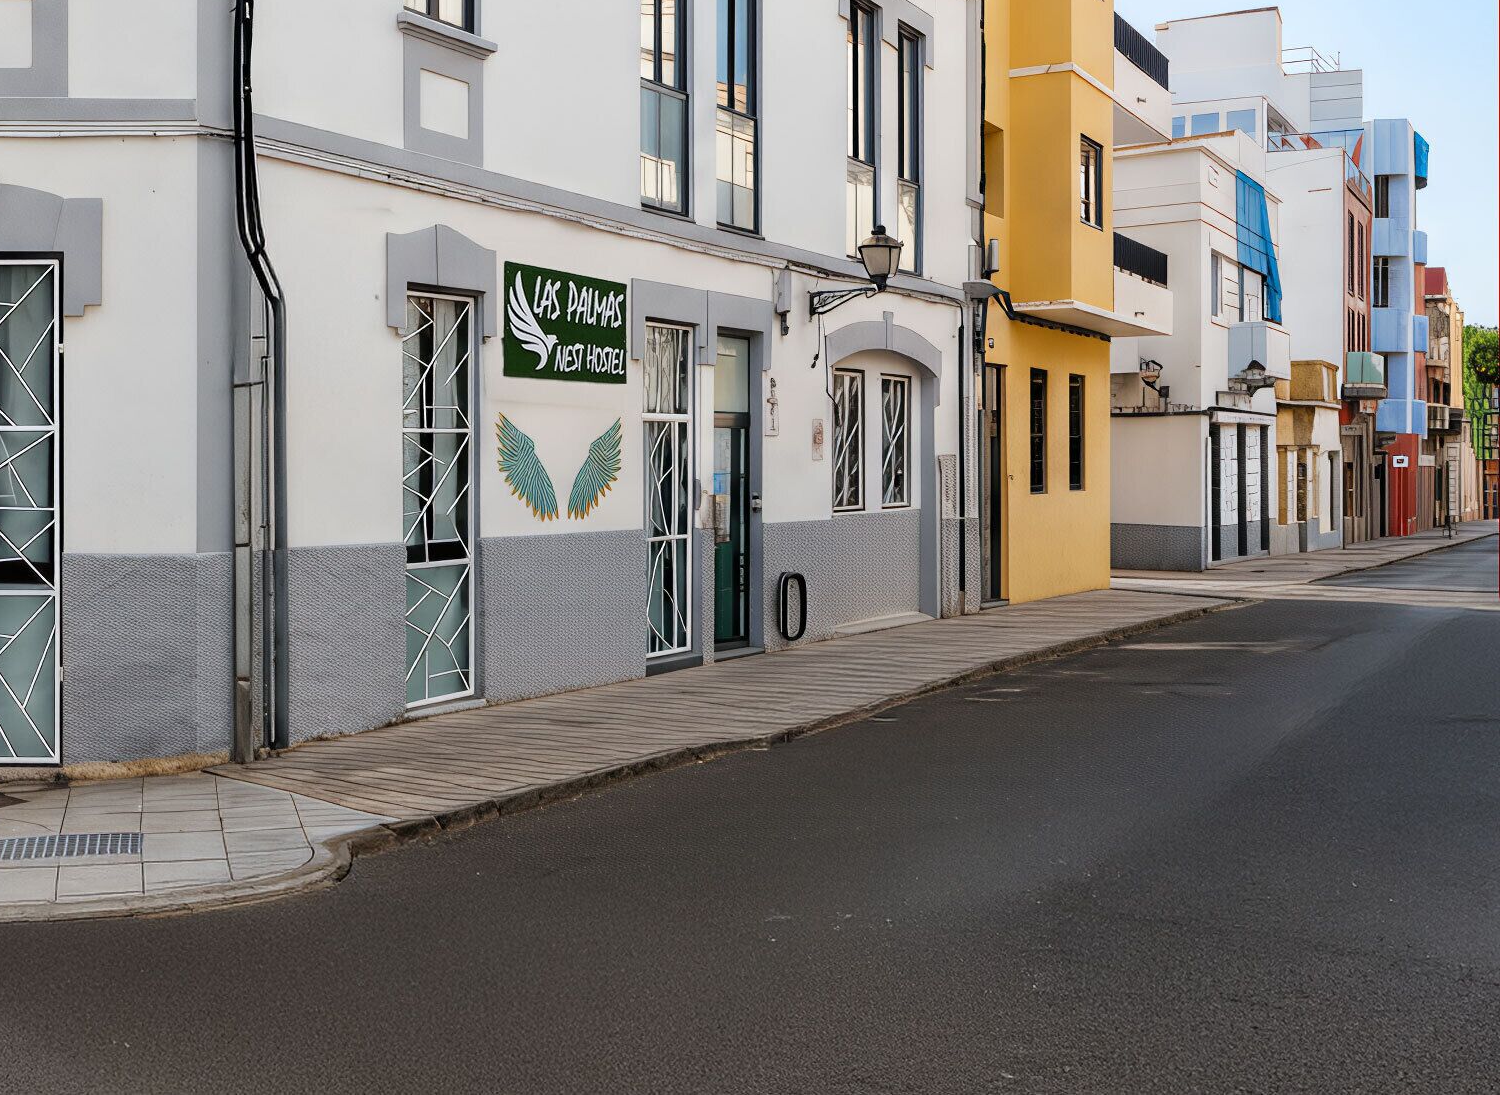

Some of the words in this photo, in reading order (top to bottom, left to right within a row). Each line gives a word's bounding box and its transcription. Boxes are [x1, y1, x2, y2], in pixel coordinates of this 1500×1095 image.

[533, 275, 561, 320] LAS
[567, 280, 624, 328] PALMAS
[554, 342, 584, 373] NEST
[586, 344, 625, 375] HOSTEL
